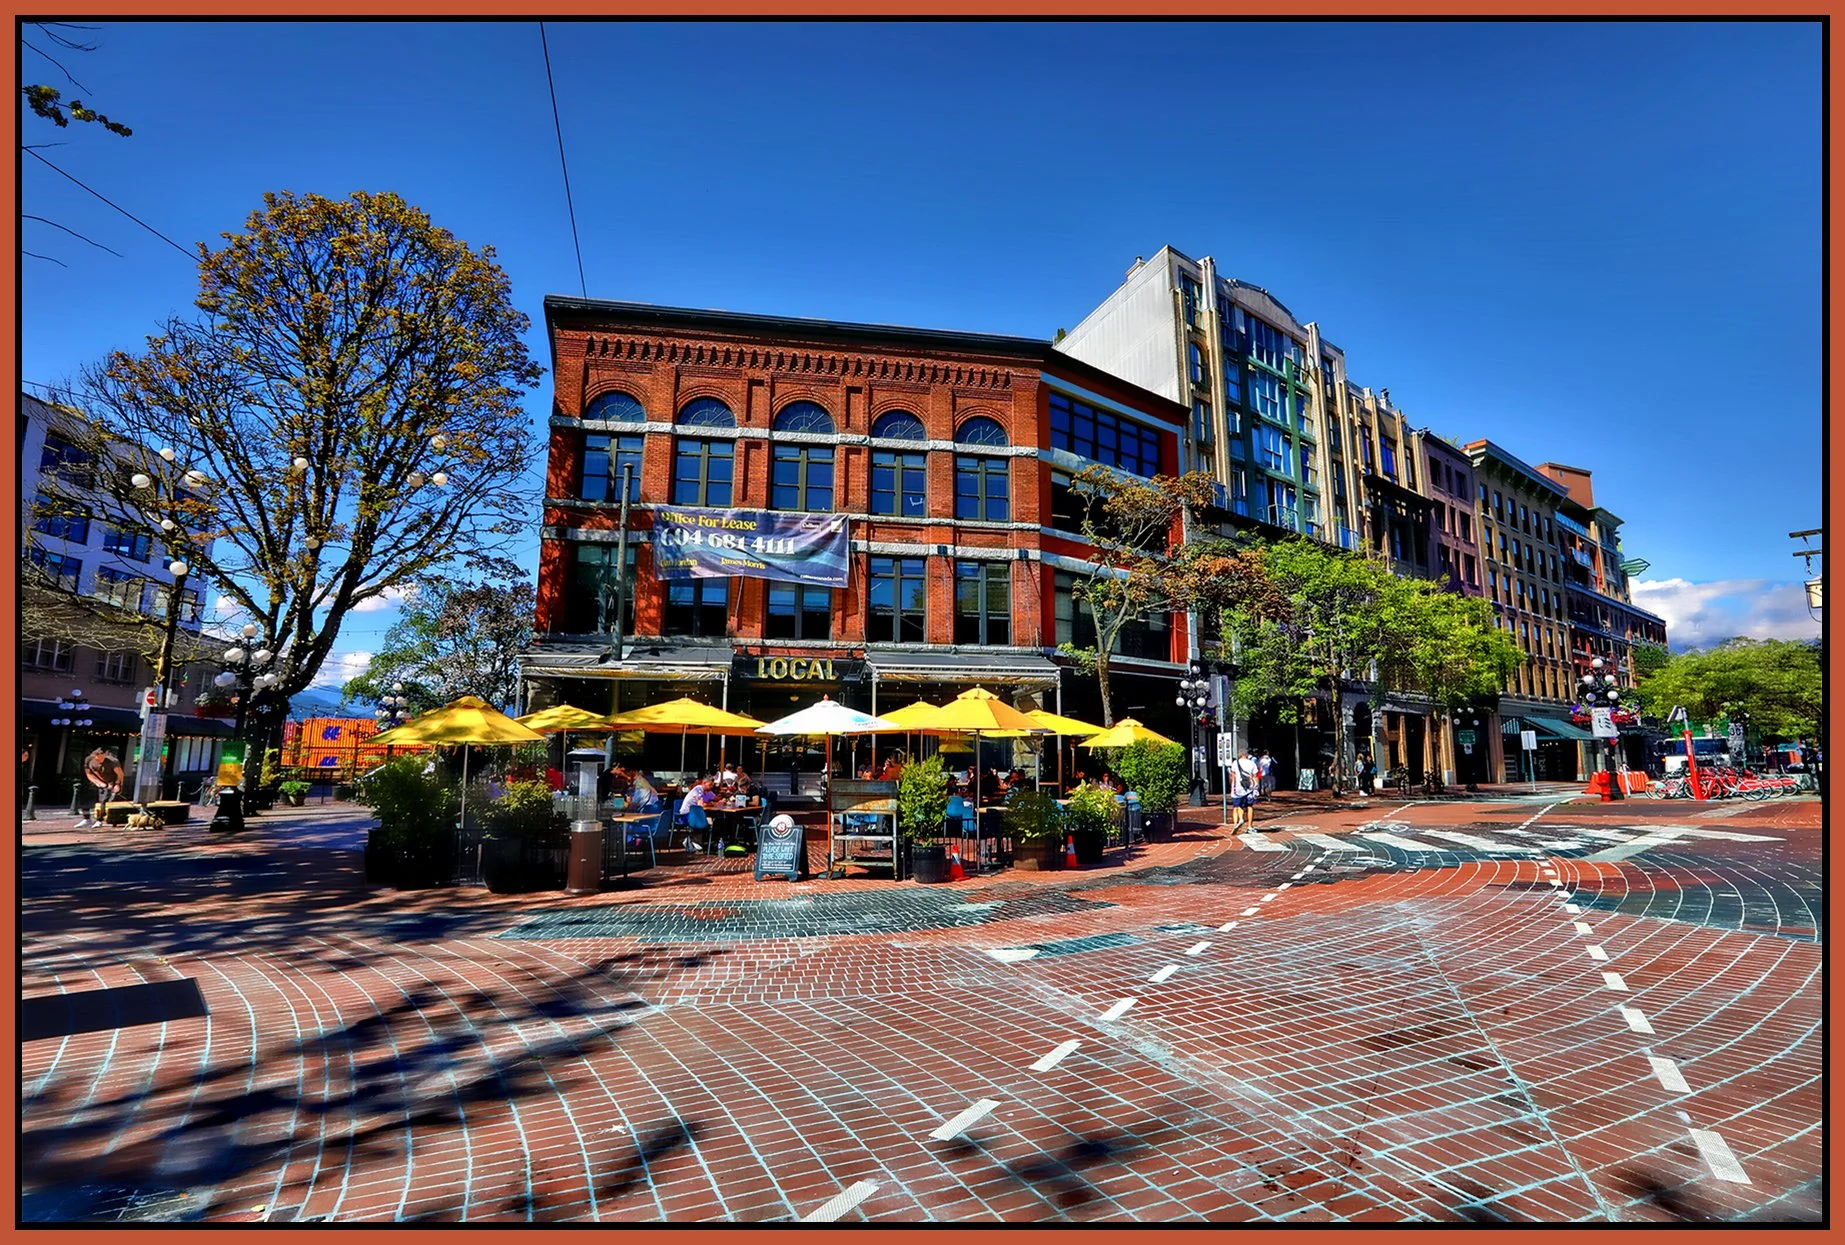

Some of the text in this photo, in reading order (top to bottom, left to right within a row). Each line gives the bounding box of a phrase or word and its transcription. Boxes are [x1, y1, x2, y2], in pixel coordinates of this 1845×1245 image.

[661, 512, 757, 531] Office For Lease
[707, 533, 747, 551] 681
[751, 536, 796, 555] 4111
[720, 557, 766, 570] James Morris
[757, 657, 838, 680] LOCAL
